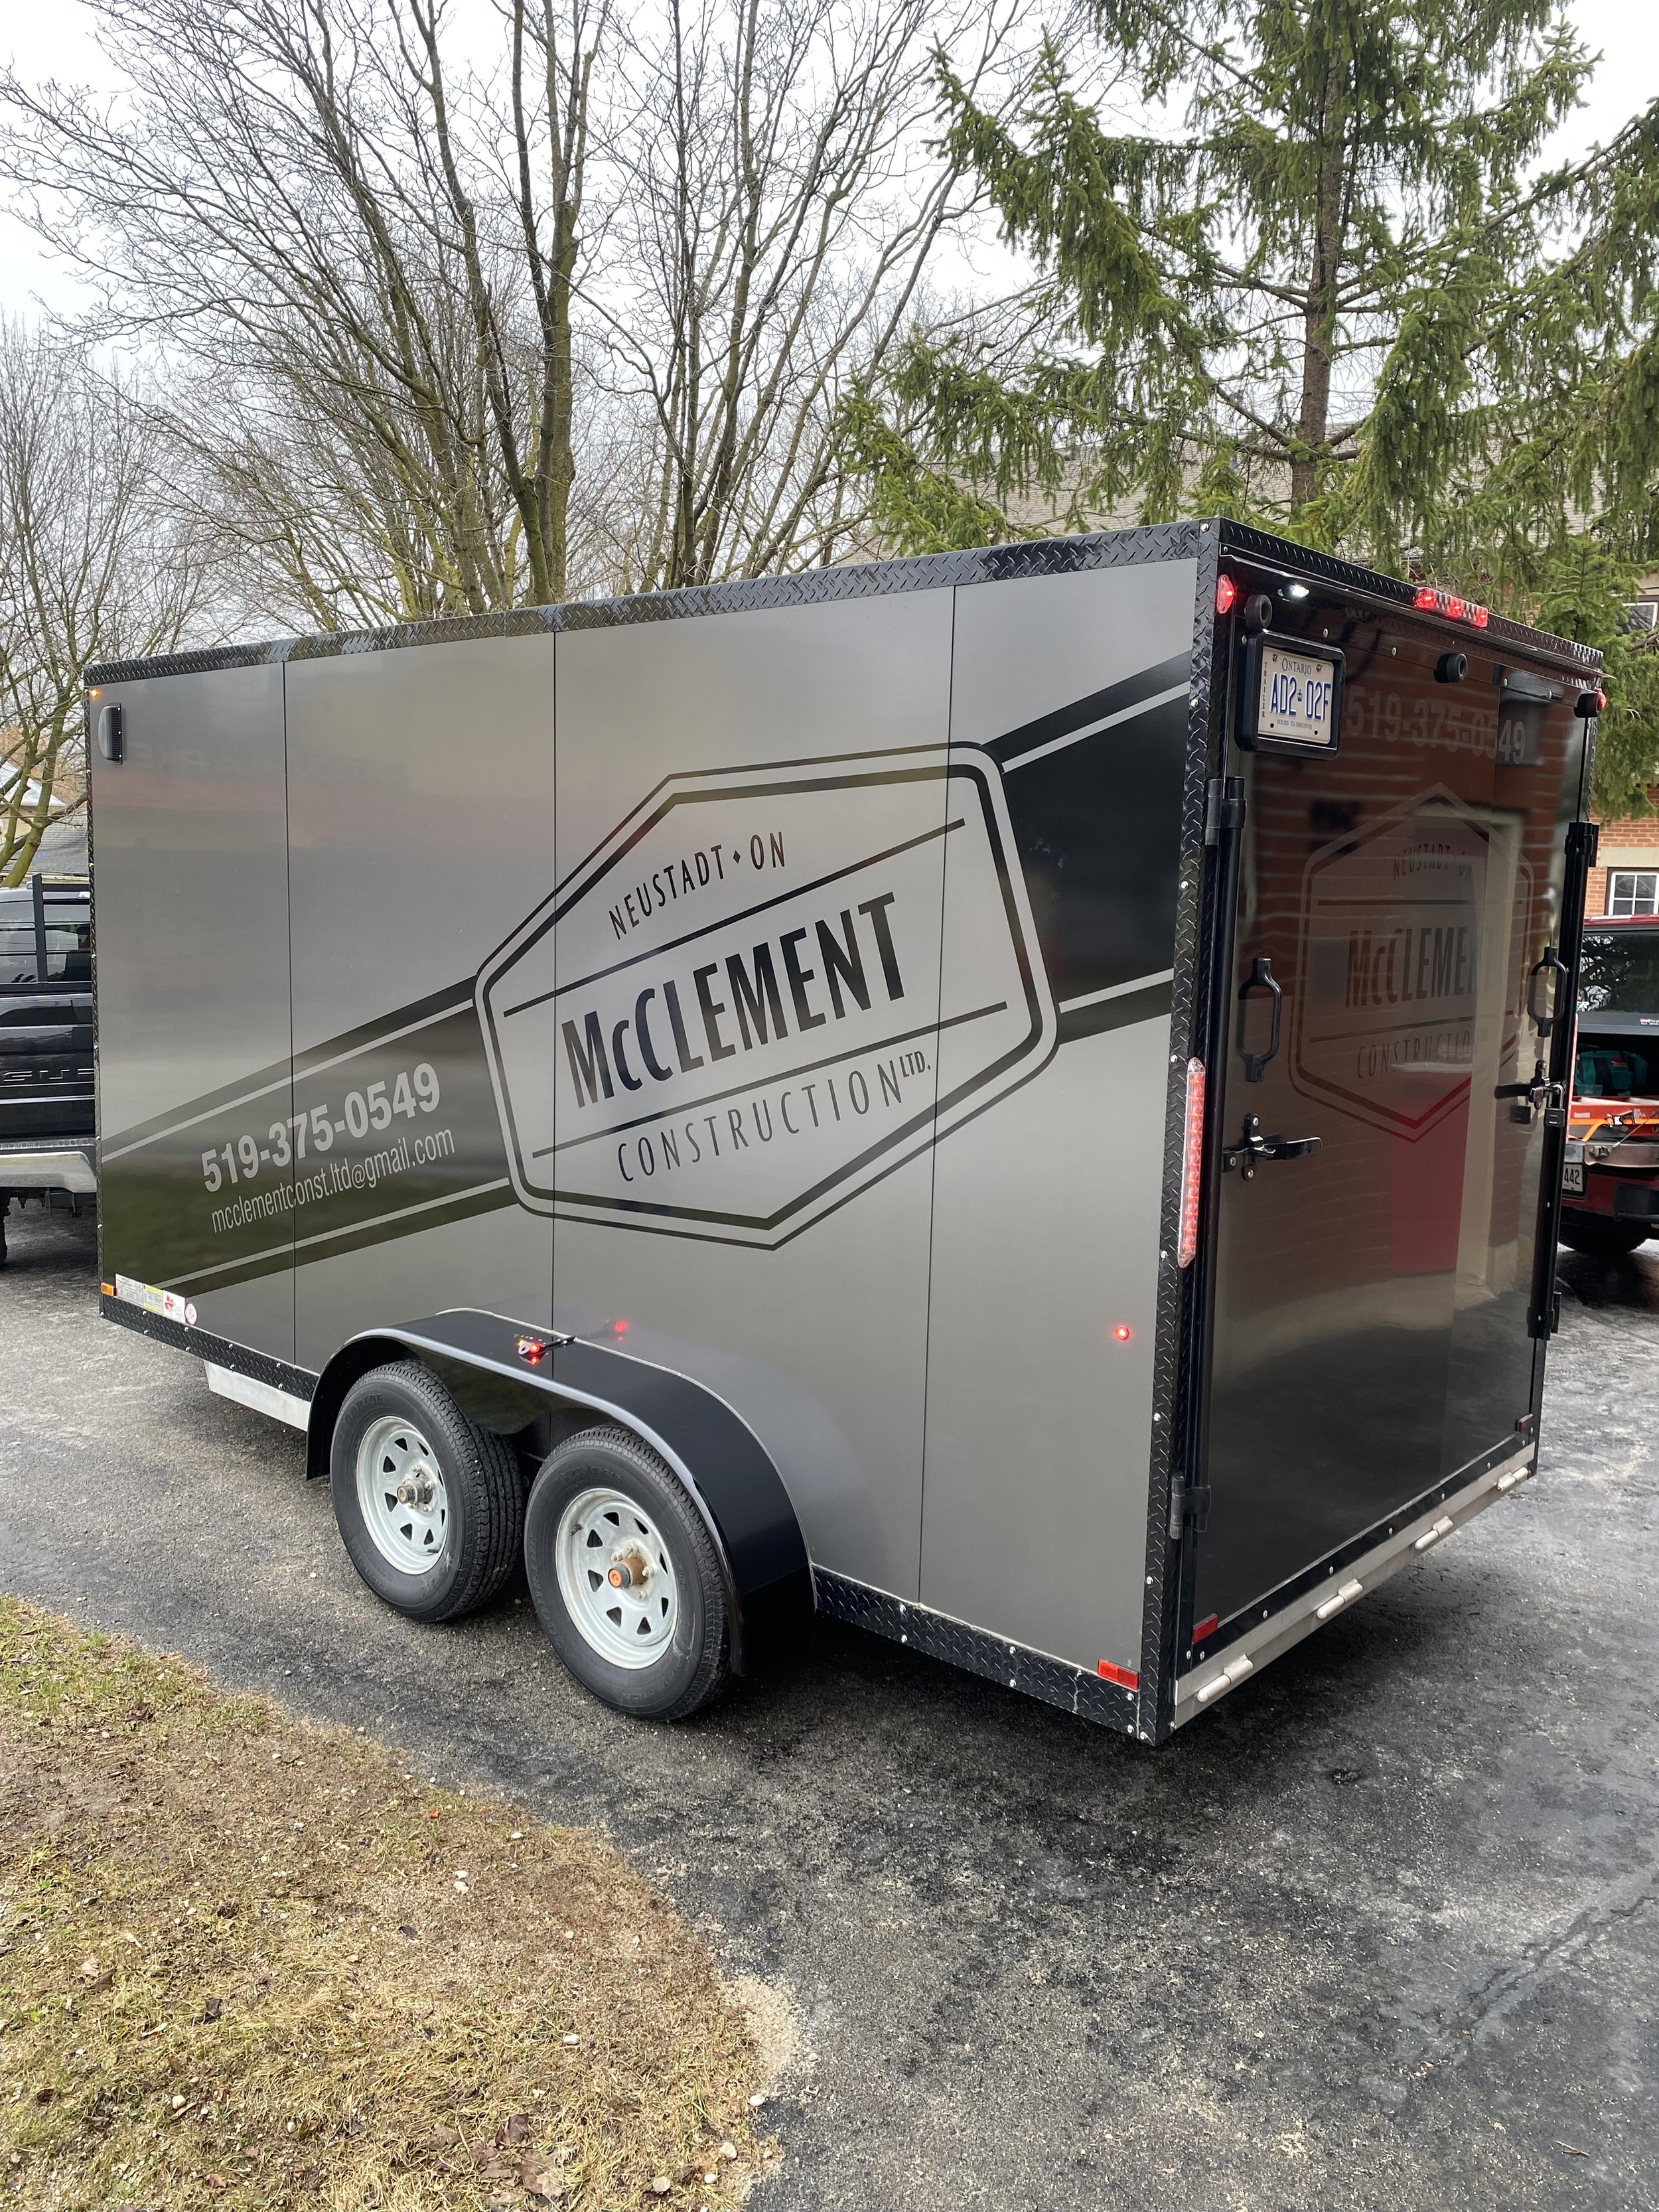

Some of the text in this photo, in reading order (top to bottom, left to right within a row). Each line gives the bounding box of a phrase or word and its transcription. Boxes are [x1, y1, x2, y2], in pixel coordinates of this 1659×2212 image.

[1281, 658, 1312, 676] ONTARIO
[1346, 684, 1526, 764] 519-375-0549
[608, 831, 786, 940] NEUSTADT ON
[561, 891, 905, 1108] McCLEMENT
[1356, 1029, 1473, 1080] CONSTRUCTIO
[201, 1063, 440, 1192] 519-375-0549
[618, 1051, 931, 1182] CONSTRUCTION LTD.
[211, 1128, 456, 1234] mcclementconst.ltd@gmail.com
[1564, 1167, 1581, 1185] 442
